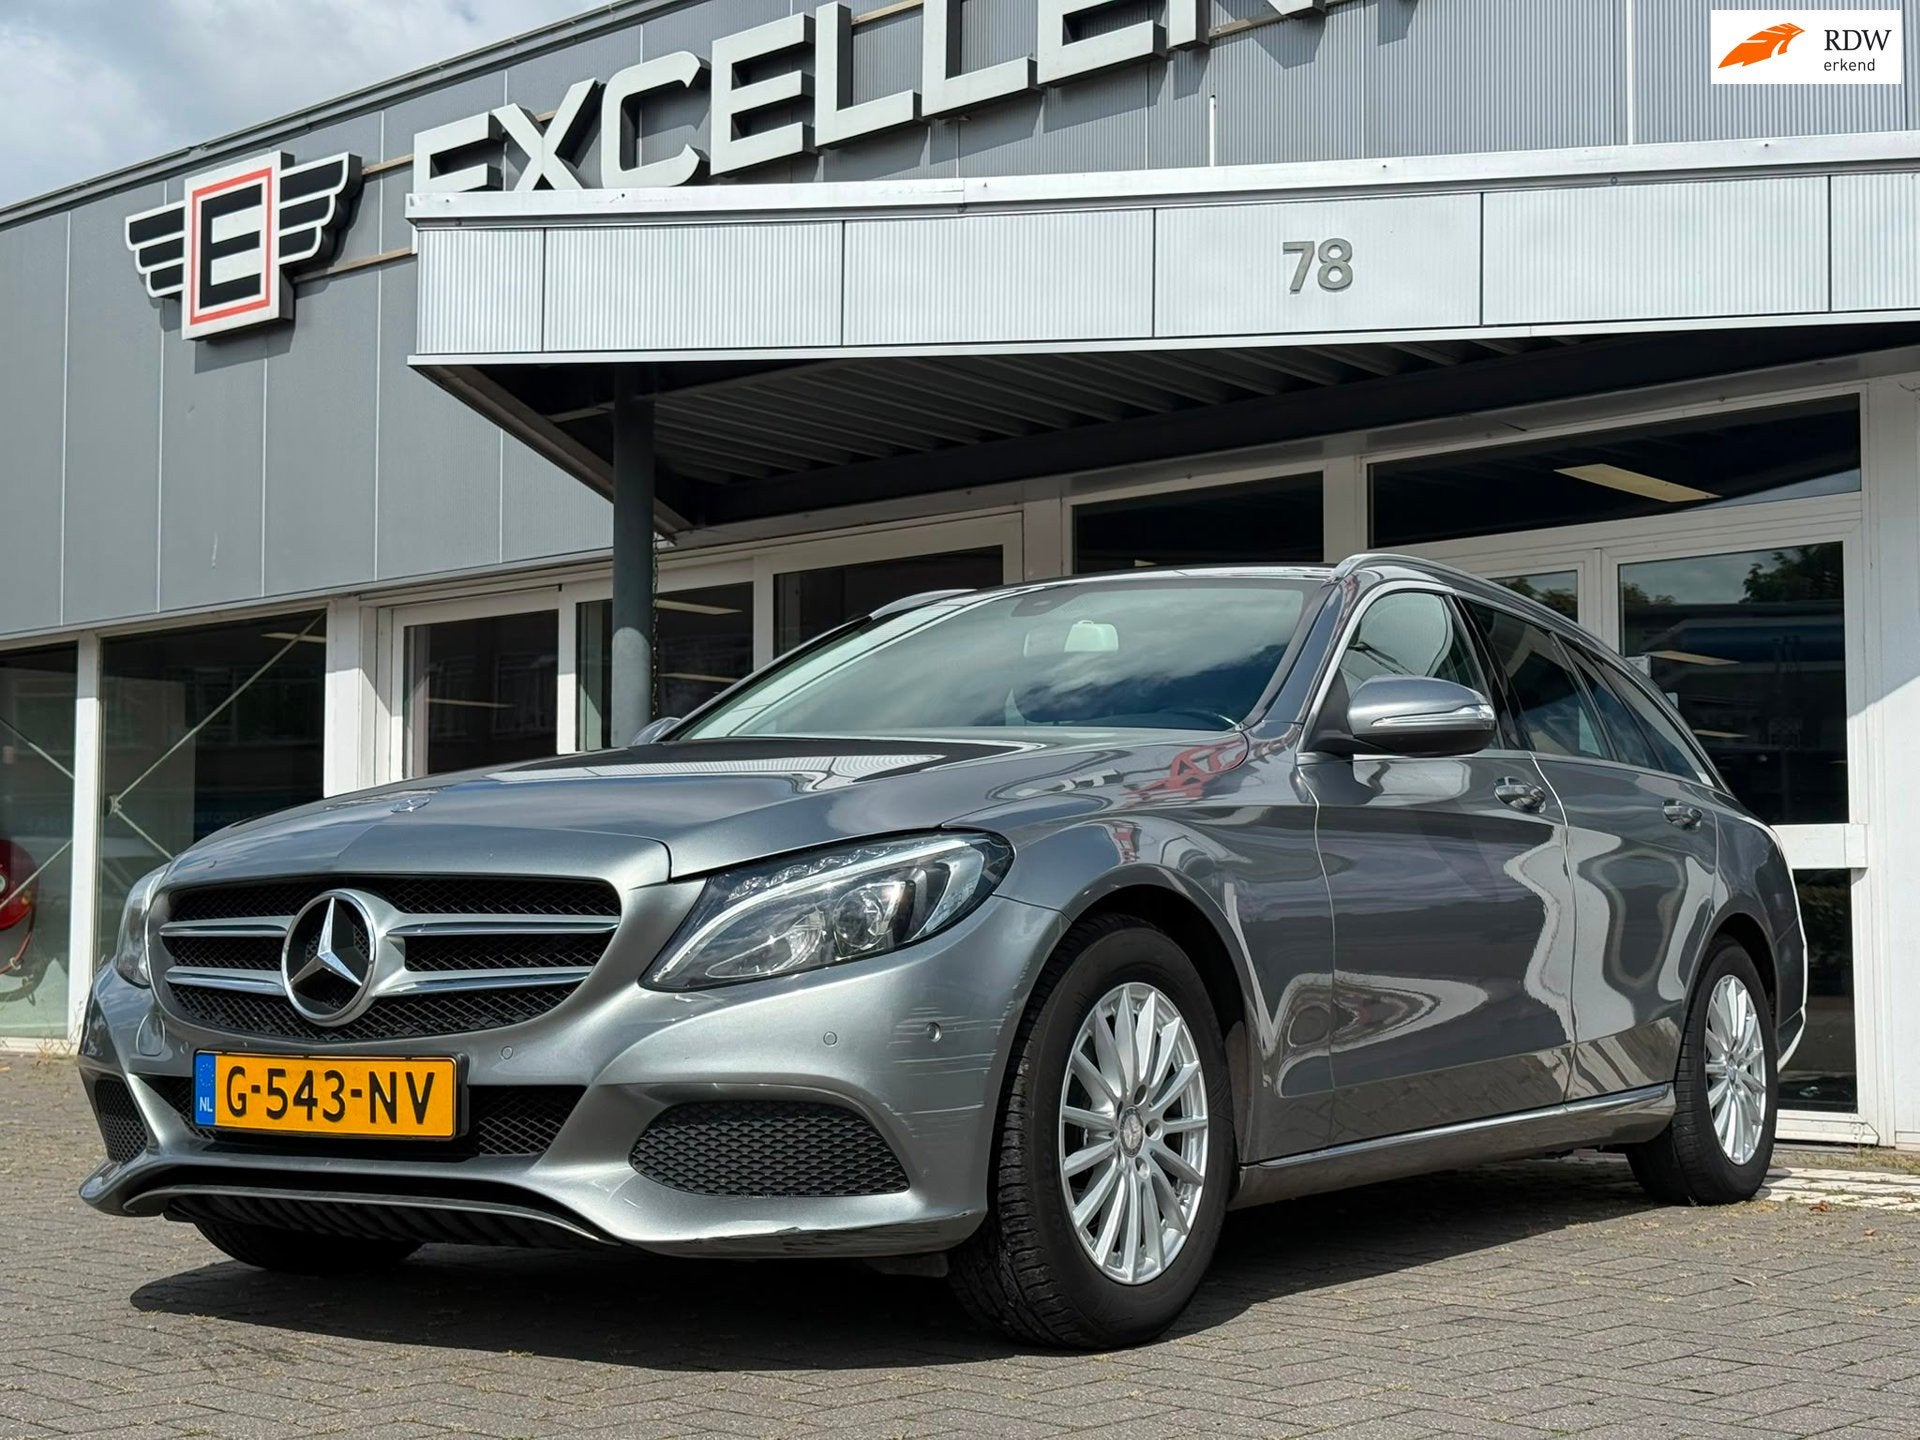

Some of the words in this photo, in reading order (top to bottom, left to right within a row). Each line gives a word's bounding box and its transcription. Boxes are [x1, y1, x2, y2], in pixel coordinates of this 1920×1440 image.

[200, 183, 262, 310] E
[1283, 238, 1353, 294] 78
[199, 1096, 213, 1112] NL
[226, 1065, 435, 1124] G-543-NV
